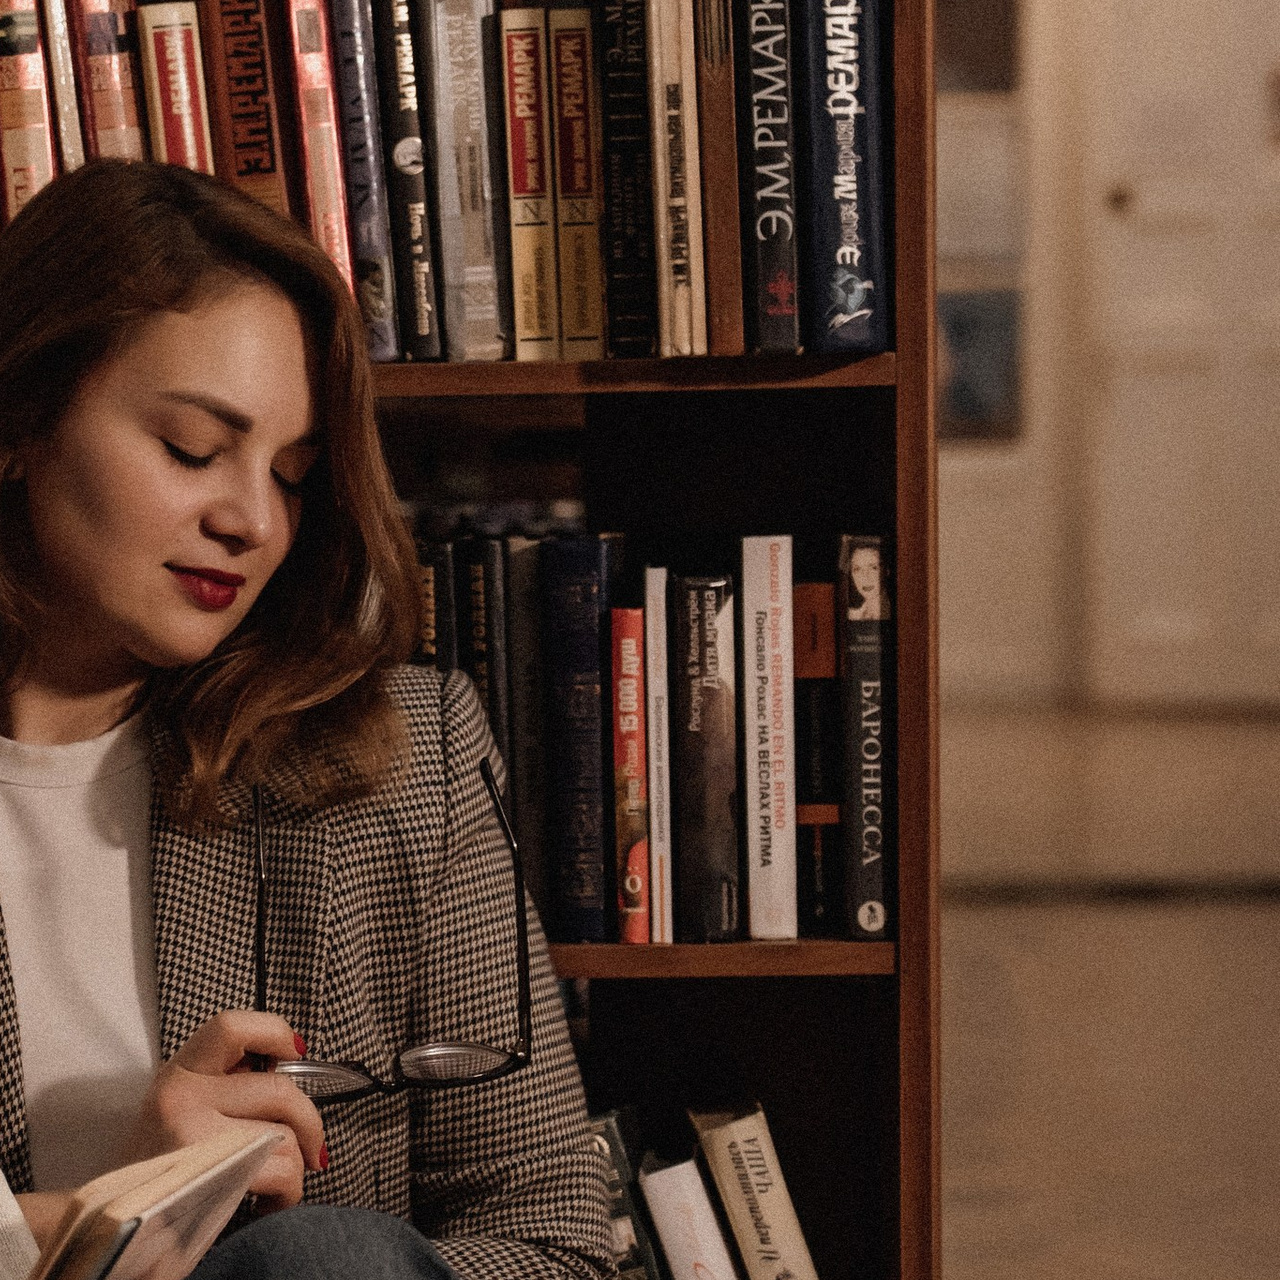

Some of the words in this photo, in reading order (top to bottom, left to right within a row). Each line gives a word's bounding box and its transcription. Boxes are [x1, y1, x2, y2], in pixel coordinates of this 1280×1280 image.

[395, 33, 418, 112] РЕМАРК
[510, 36, 540, 118] РЕМАРК
[557, 37, 584, 118] РЕМАРК
[619, 638, 641, 675] душ
[756, 676, 769, 720] Рохас
[771, 653, 783, 730] REMANDO
[620, 712, 639, 733] 15
[757, 725, 769, 746] НА
[773, 735, 784, 755] EN
[758, 750, 770, 811] ВЕСЛАХ
[773, 759, 784, 777] EL
[860, 680, 882, 865] БАРОНЕССА
[773, 781, 786, 830] RITMO
[759, 815, 772, 868] РИТМА
